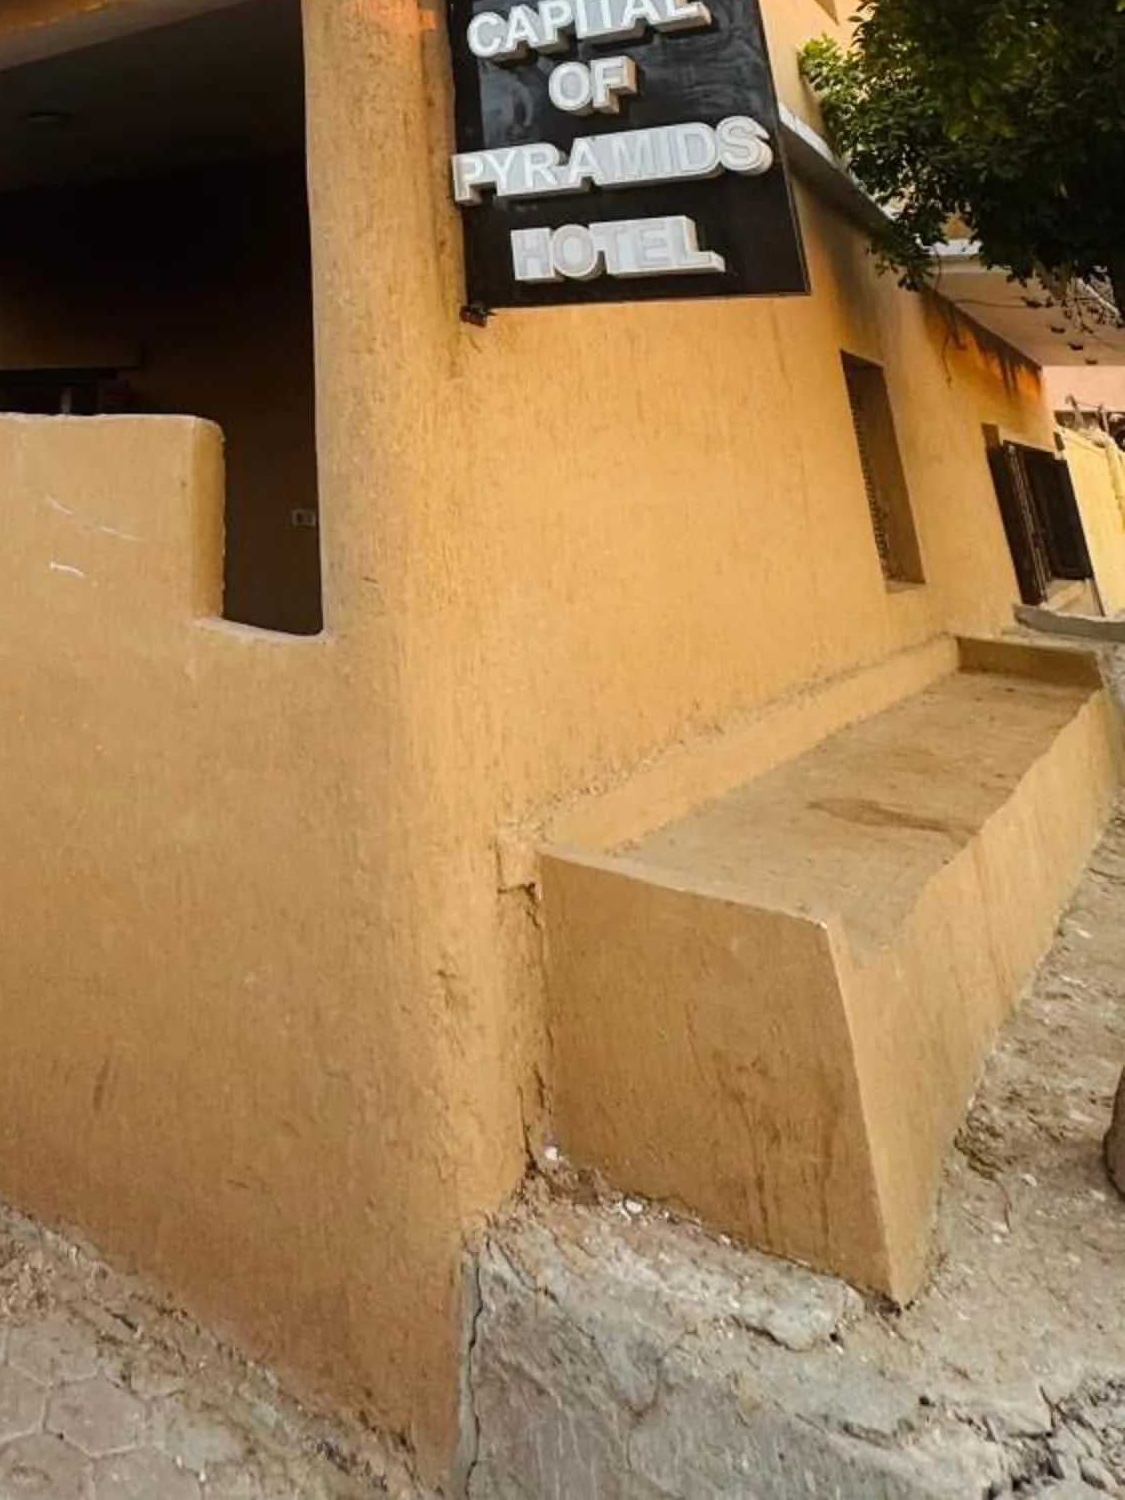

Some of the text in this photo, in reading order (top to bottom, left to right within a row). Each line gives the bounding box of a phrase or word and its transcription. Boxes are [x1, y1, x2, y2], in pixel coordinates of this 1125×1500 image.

[549, 56, 636, 113] OF
[451, 116, 772, 202] PYRAMIDS
[510, 216, 725, 281] HOTEL
